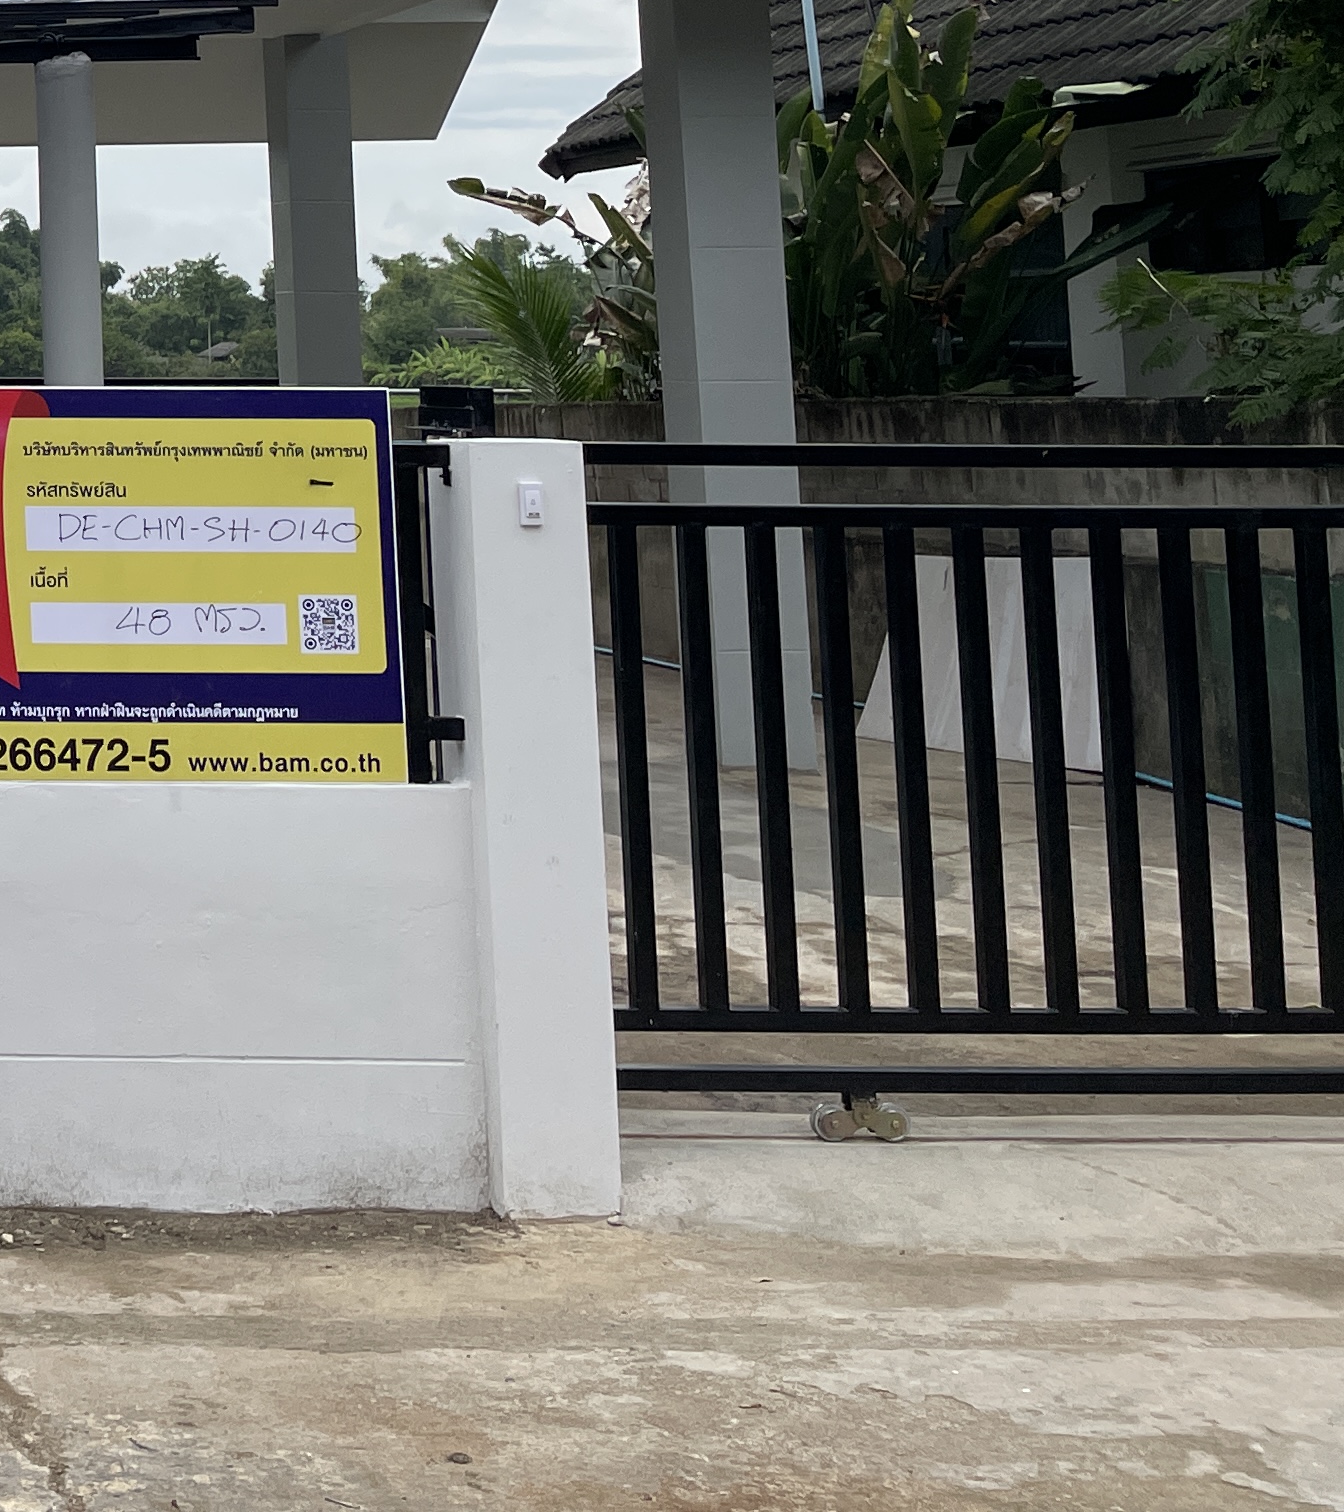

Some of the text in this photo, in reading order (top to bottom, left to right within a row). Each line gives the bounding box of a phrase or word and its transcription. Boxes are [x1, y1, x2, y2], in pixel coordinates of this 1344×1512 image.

[22, 440, 368, 462] บริษัทบริหารสินทรัพย์กรุงเทพพาณิชย์ จำกัด (มหาชน)
[26, 480, 128, 499] รหัสทรัพย์สิน
[58, 512, 363, 544] DE-CHM-SH-0140
[30, 566, 69, 589] เนื้อที่
[115, 605, 172, 636] 48
[10, 701, 71, 722] ห้ามบุกรุก
[187, 751, 382, 773] www.bam.co.th
